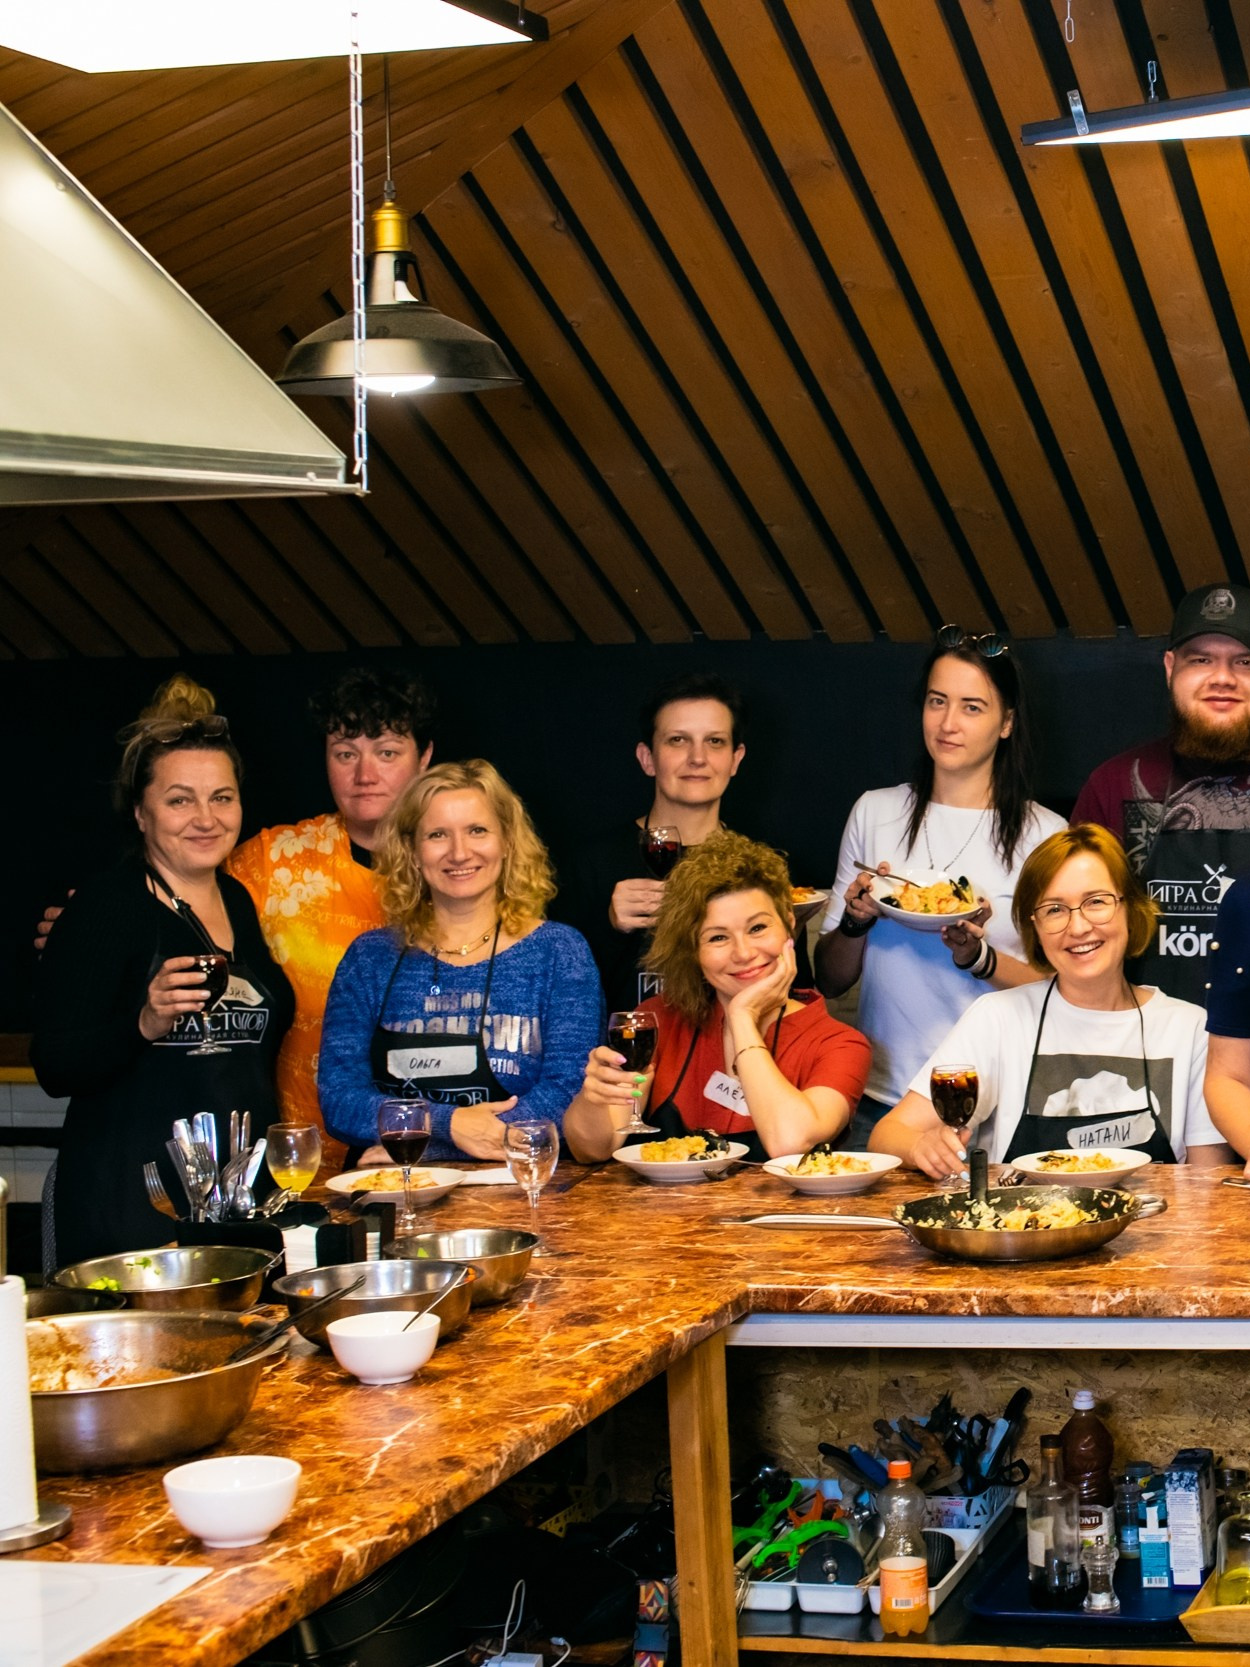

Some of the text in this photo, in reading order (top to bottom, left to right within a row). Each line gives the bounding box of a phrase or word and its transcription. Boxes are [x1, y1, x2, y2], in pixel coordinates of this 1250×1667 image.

[173, 1015, 200, 1032] РА
[409, 1057, 442, 1070] ОЛЬГА
[1078, 1121, 1131, 1148] НАТАЛИ
[1080, 1516, 1100, 1525] ONTI
